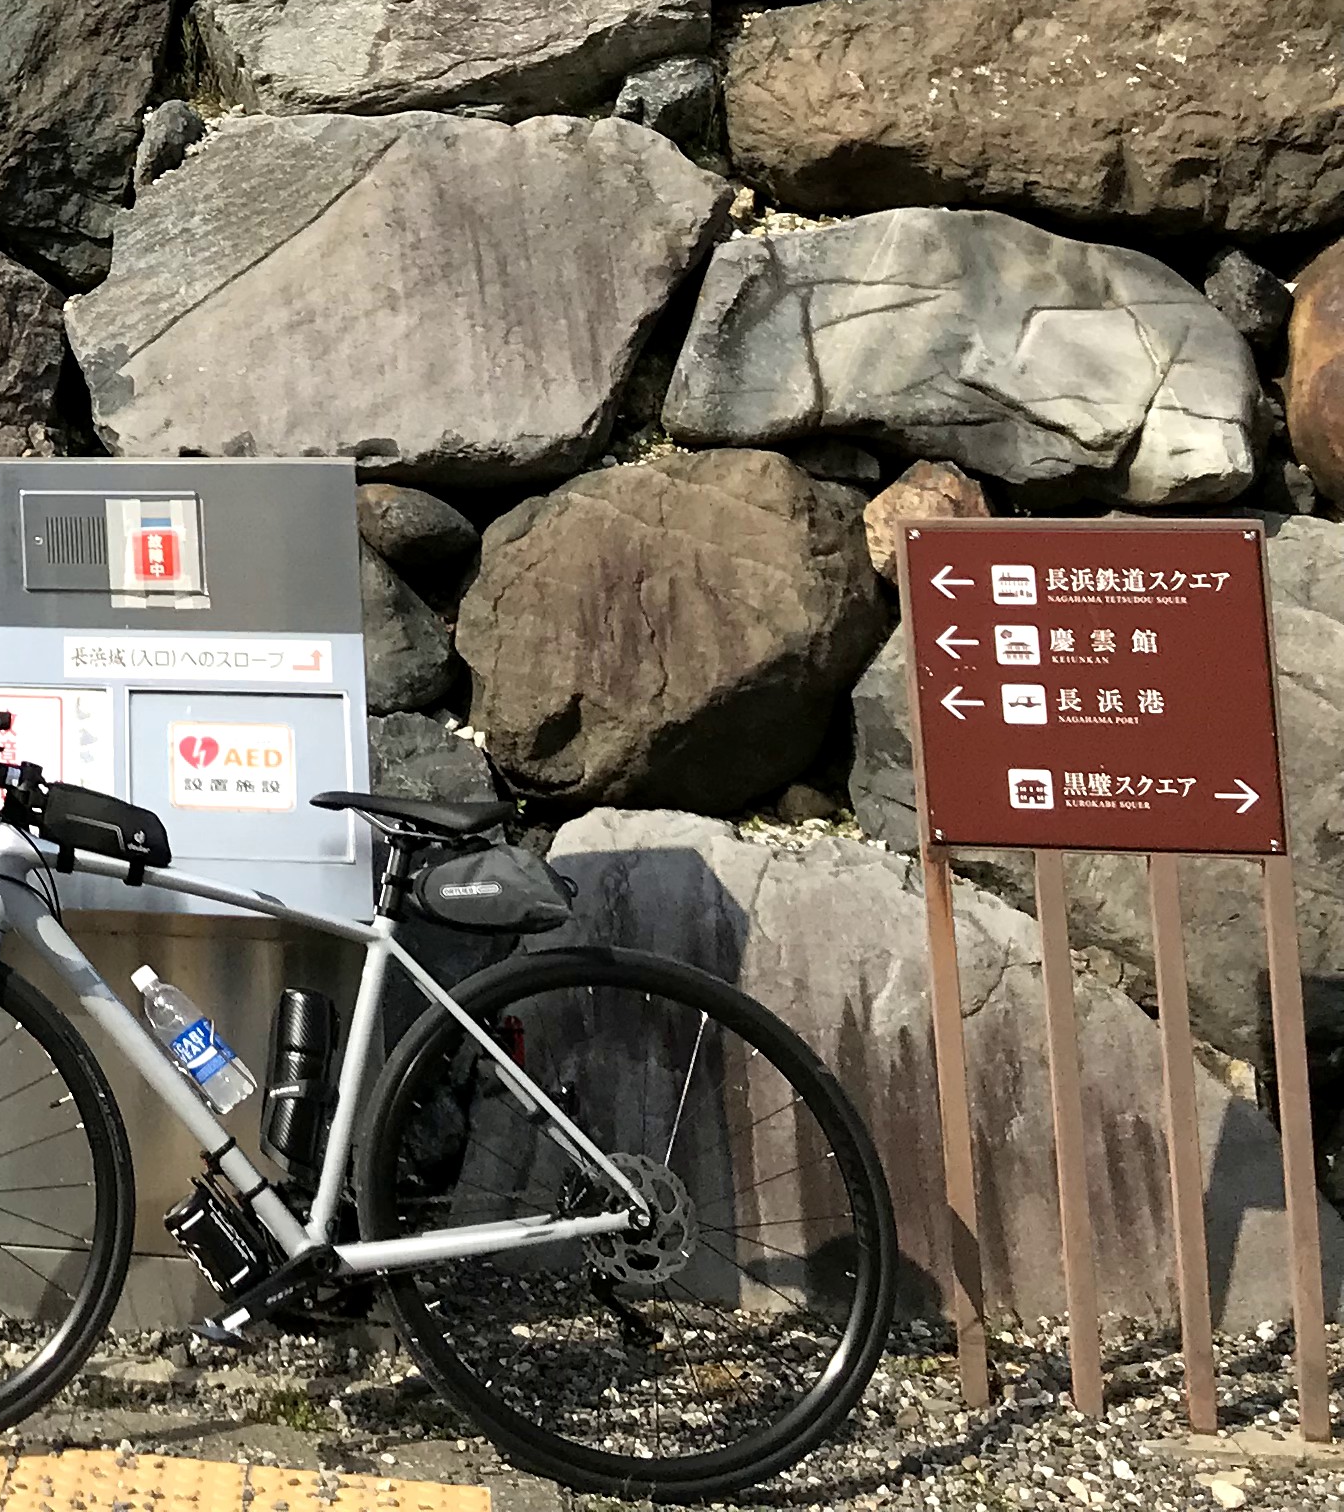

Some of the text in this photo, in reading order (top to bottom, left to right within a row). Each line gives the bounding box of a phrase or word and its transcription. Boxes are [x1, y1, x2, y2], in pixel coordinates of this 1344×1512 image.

[1045, 568, 1231, 592] 長浜鉄道スクエア
[1047, 595, 1188, 605] NAGAHAMA TETSUDOU SQUER
[1049, 628, 1158, 653] 慶雲館
[1051, 655, 1110, 664] KEIUNKAN
[1056, 688, 1165, 713] 長浜港
[1058, 715, 1139, 724] NAGAHAMA PORT
[224, 748, 283, 768] AED
[1063, 771, 1197, 797] 黒壁スクエア
[1065, 799, 1150, 809] KUROKABE SQUER
